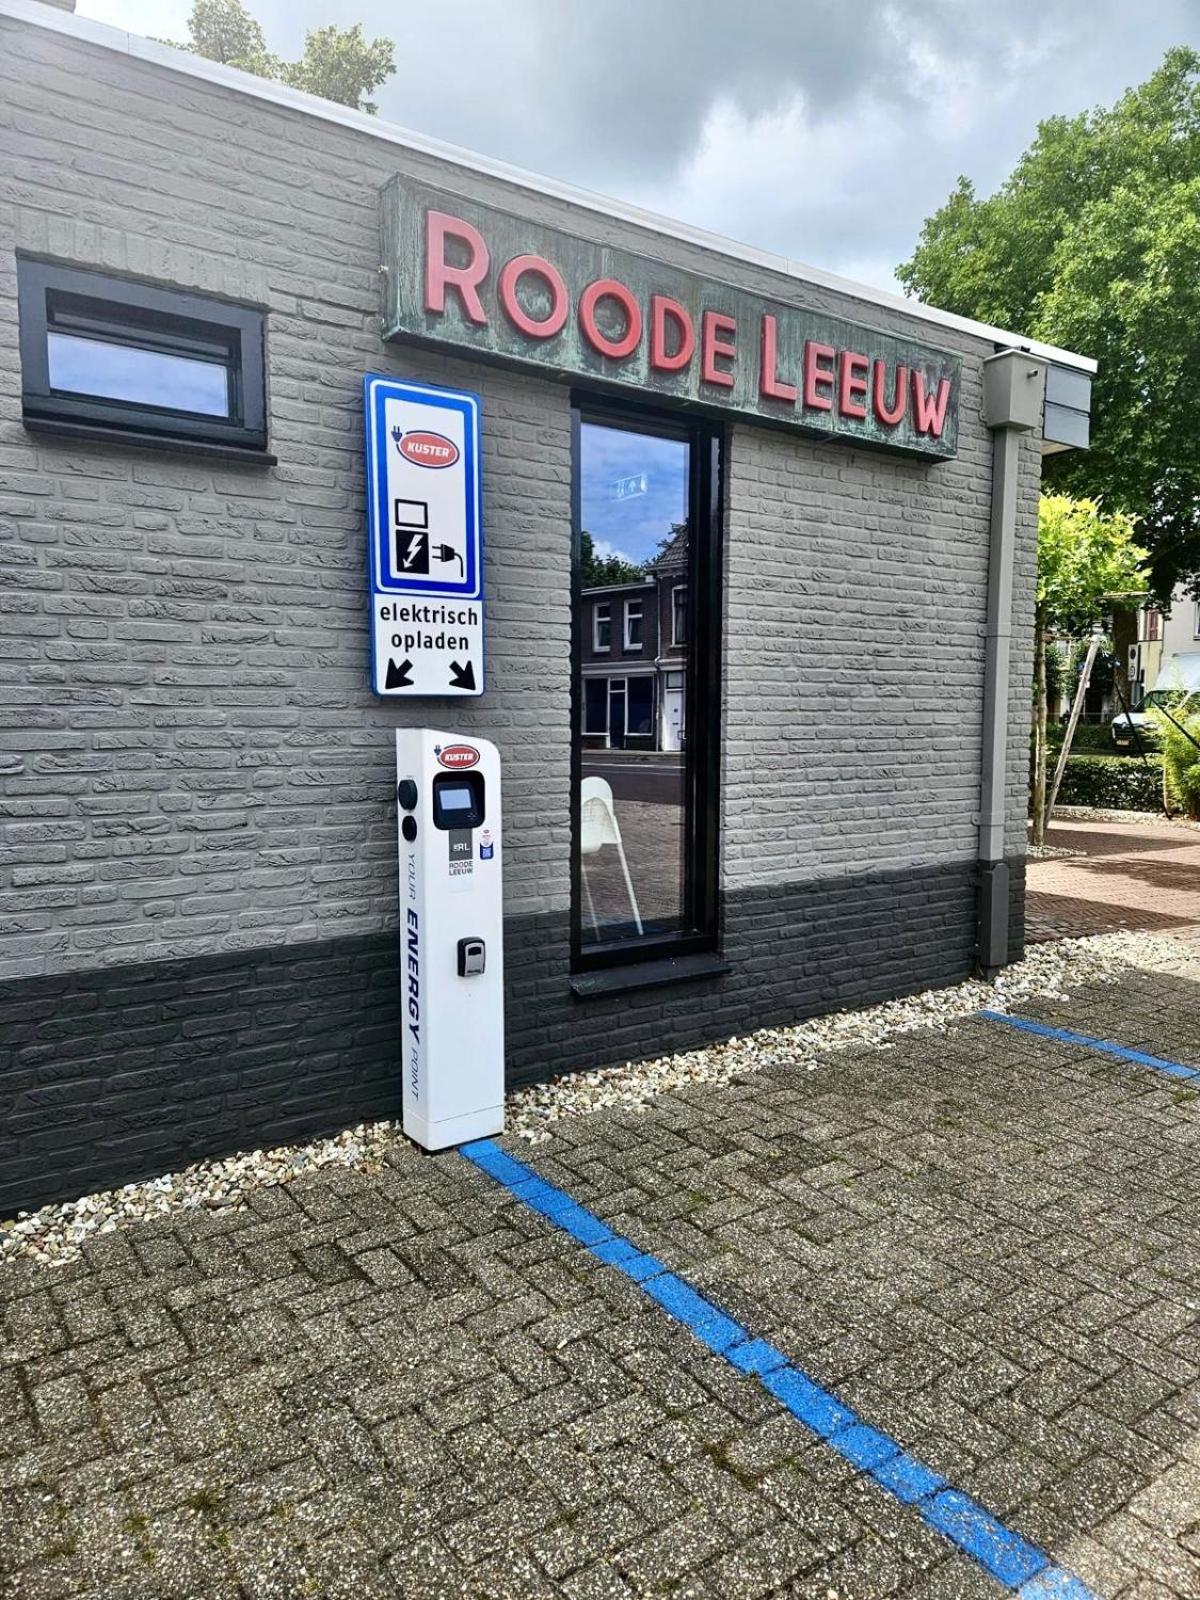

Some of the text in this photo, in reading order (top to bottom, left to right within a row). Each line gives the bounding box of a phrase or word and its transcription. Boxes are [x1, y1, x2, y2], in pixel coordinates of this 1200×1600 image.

[425, 209, 952, 439] ROODE LEEUW
[407, 442, 450, 458] KUSTER
[380, 602, 478, 626] elektrisch
[391, 630, 469, 653] opladen
[407, 854, 420, 1102] YOUR ENERGY POINT
